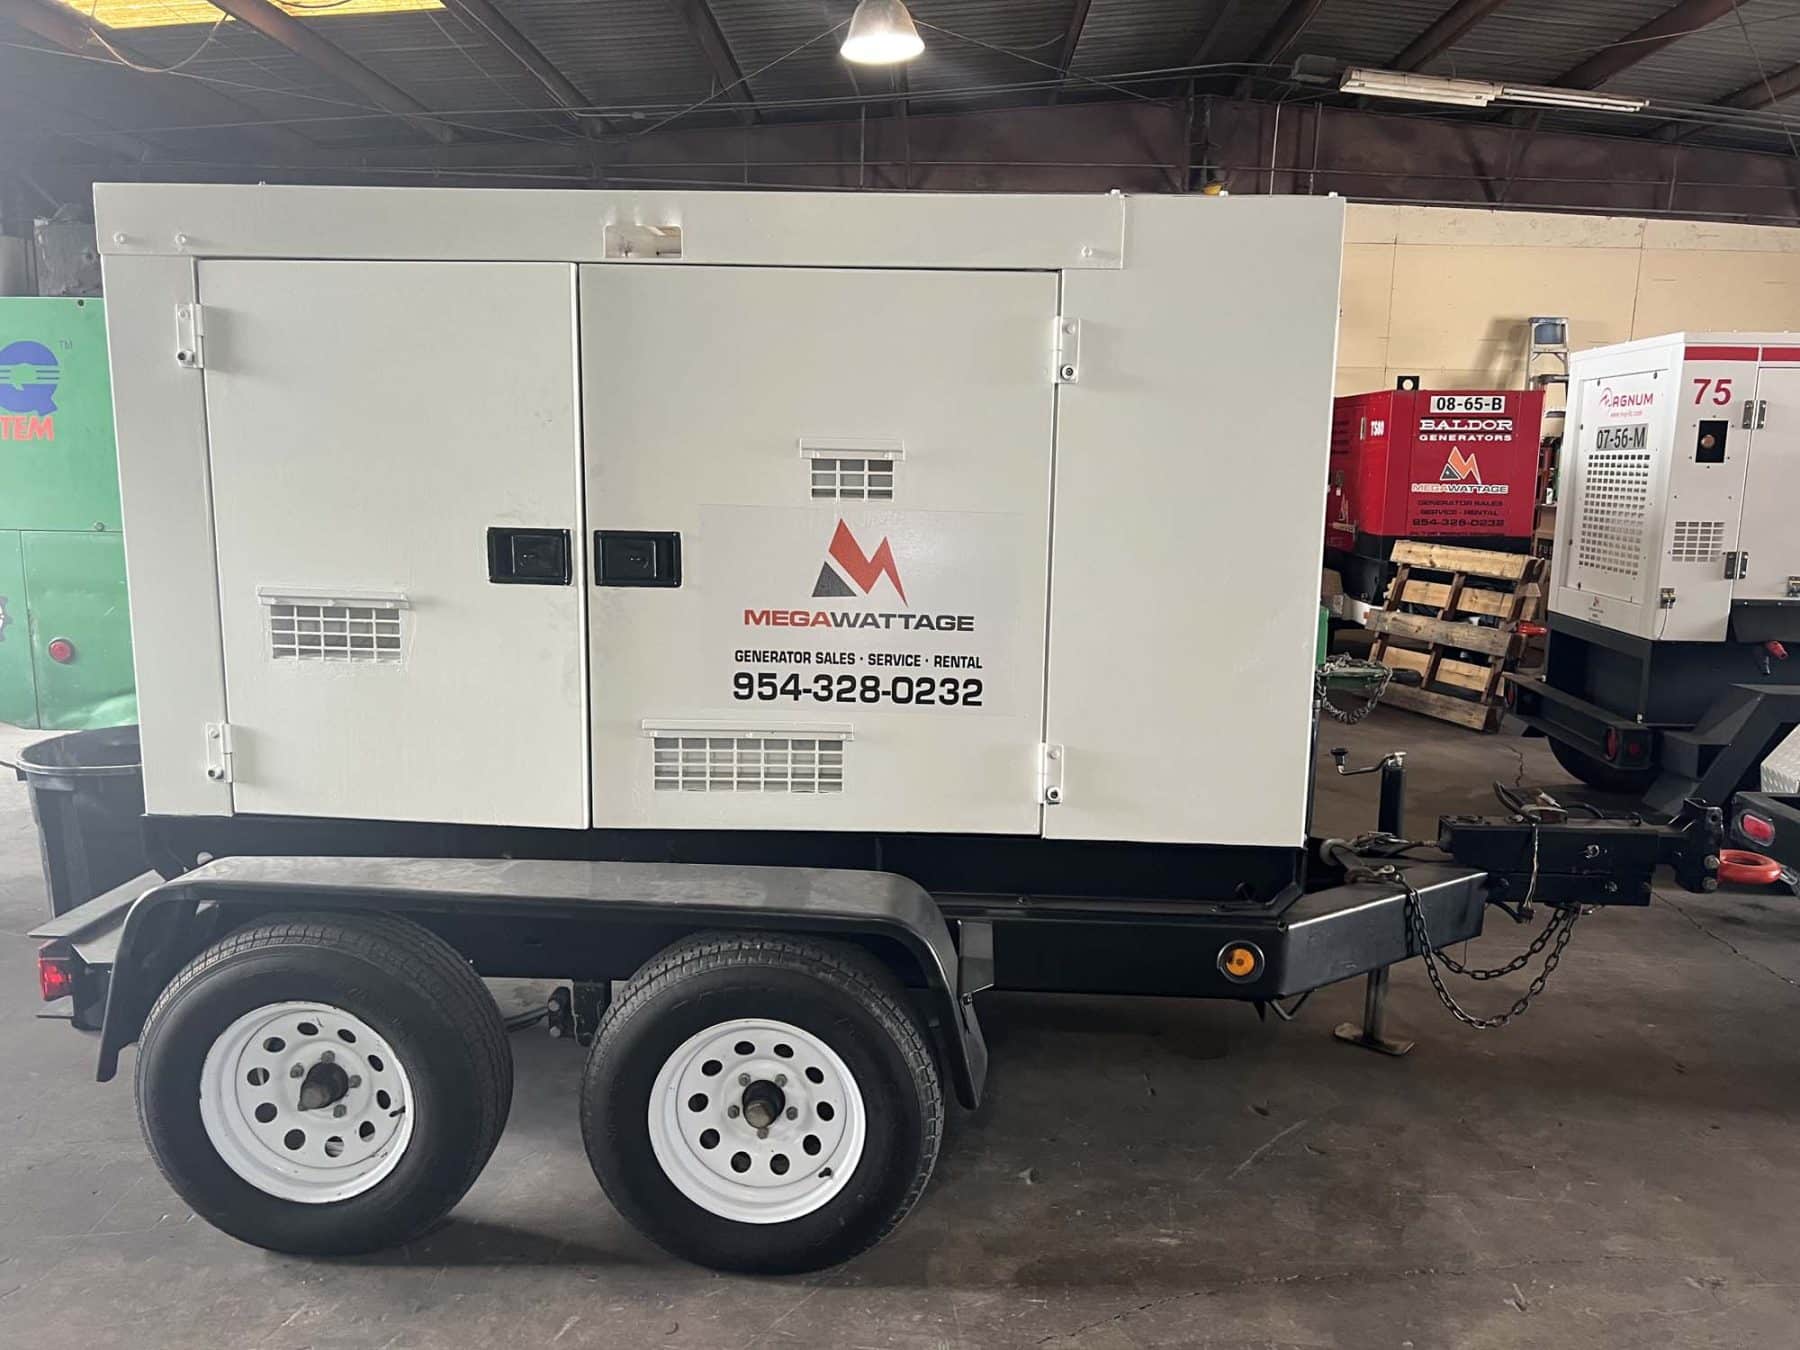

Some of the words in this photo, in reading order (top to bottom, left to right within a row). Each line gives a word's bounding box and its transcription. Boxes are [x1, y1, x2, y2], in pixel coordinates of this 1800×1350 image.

[1693, 378, 1732, 405] 75
[1436, 397, 1503, 411] 08-65-B
[1419, 419, 1513, 431] BALDOR
[1419, 434, 1512, 442] GENERATORS
[1596, 427, 1645, 449] 07-56-M
[1412, 484, 1508, 494] MEGAWATTAGE
[744, 609, 975, 632] MEGAWATTAGE
[735, 650, 811, 665] GENERATOR
[815, 652, 856, 665] SALES
[867, 653, 921, 667] SERVICE
[933, 655, 983, 669] RENTAL
[733, 672, 984, 707] 954-328-0232
